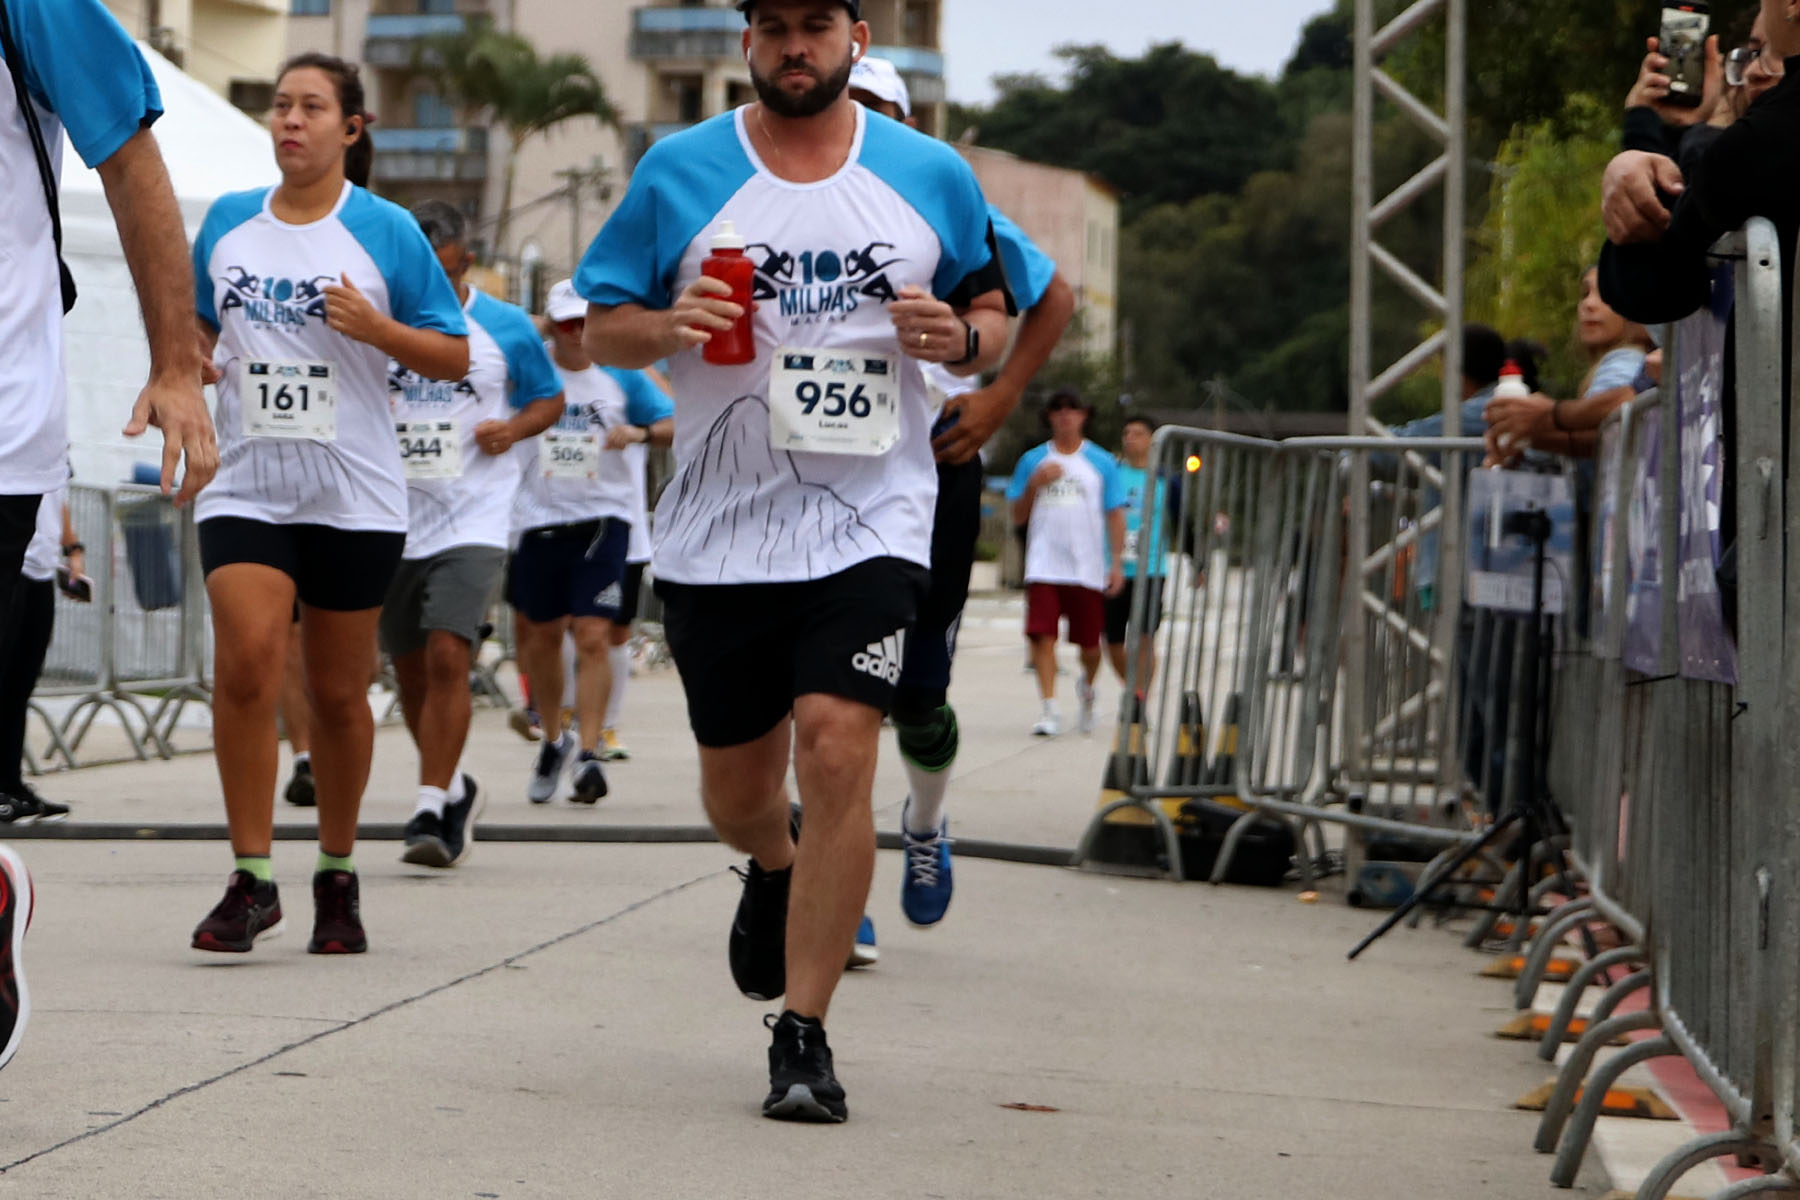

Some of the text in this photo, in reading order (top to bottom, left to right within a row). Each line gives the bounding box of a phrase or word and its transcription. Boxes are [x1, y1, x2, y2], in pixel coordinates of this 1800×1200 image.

[799, 250, 841, 284] 10
[244, 299, 306, 326] MILHAS
[778, 286, 860, 317] MILHAS
[258, 382, 309, 411] 161
[795, 381, 871, 418] 956
[400, 438, 441, 458] 344
